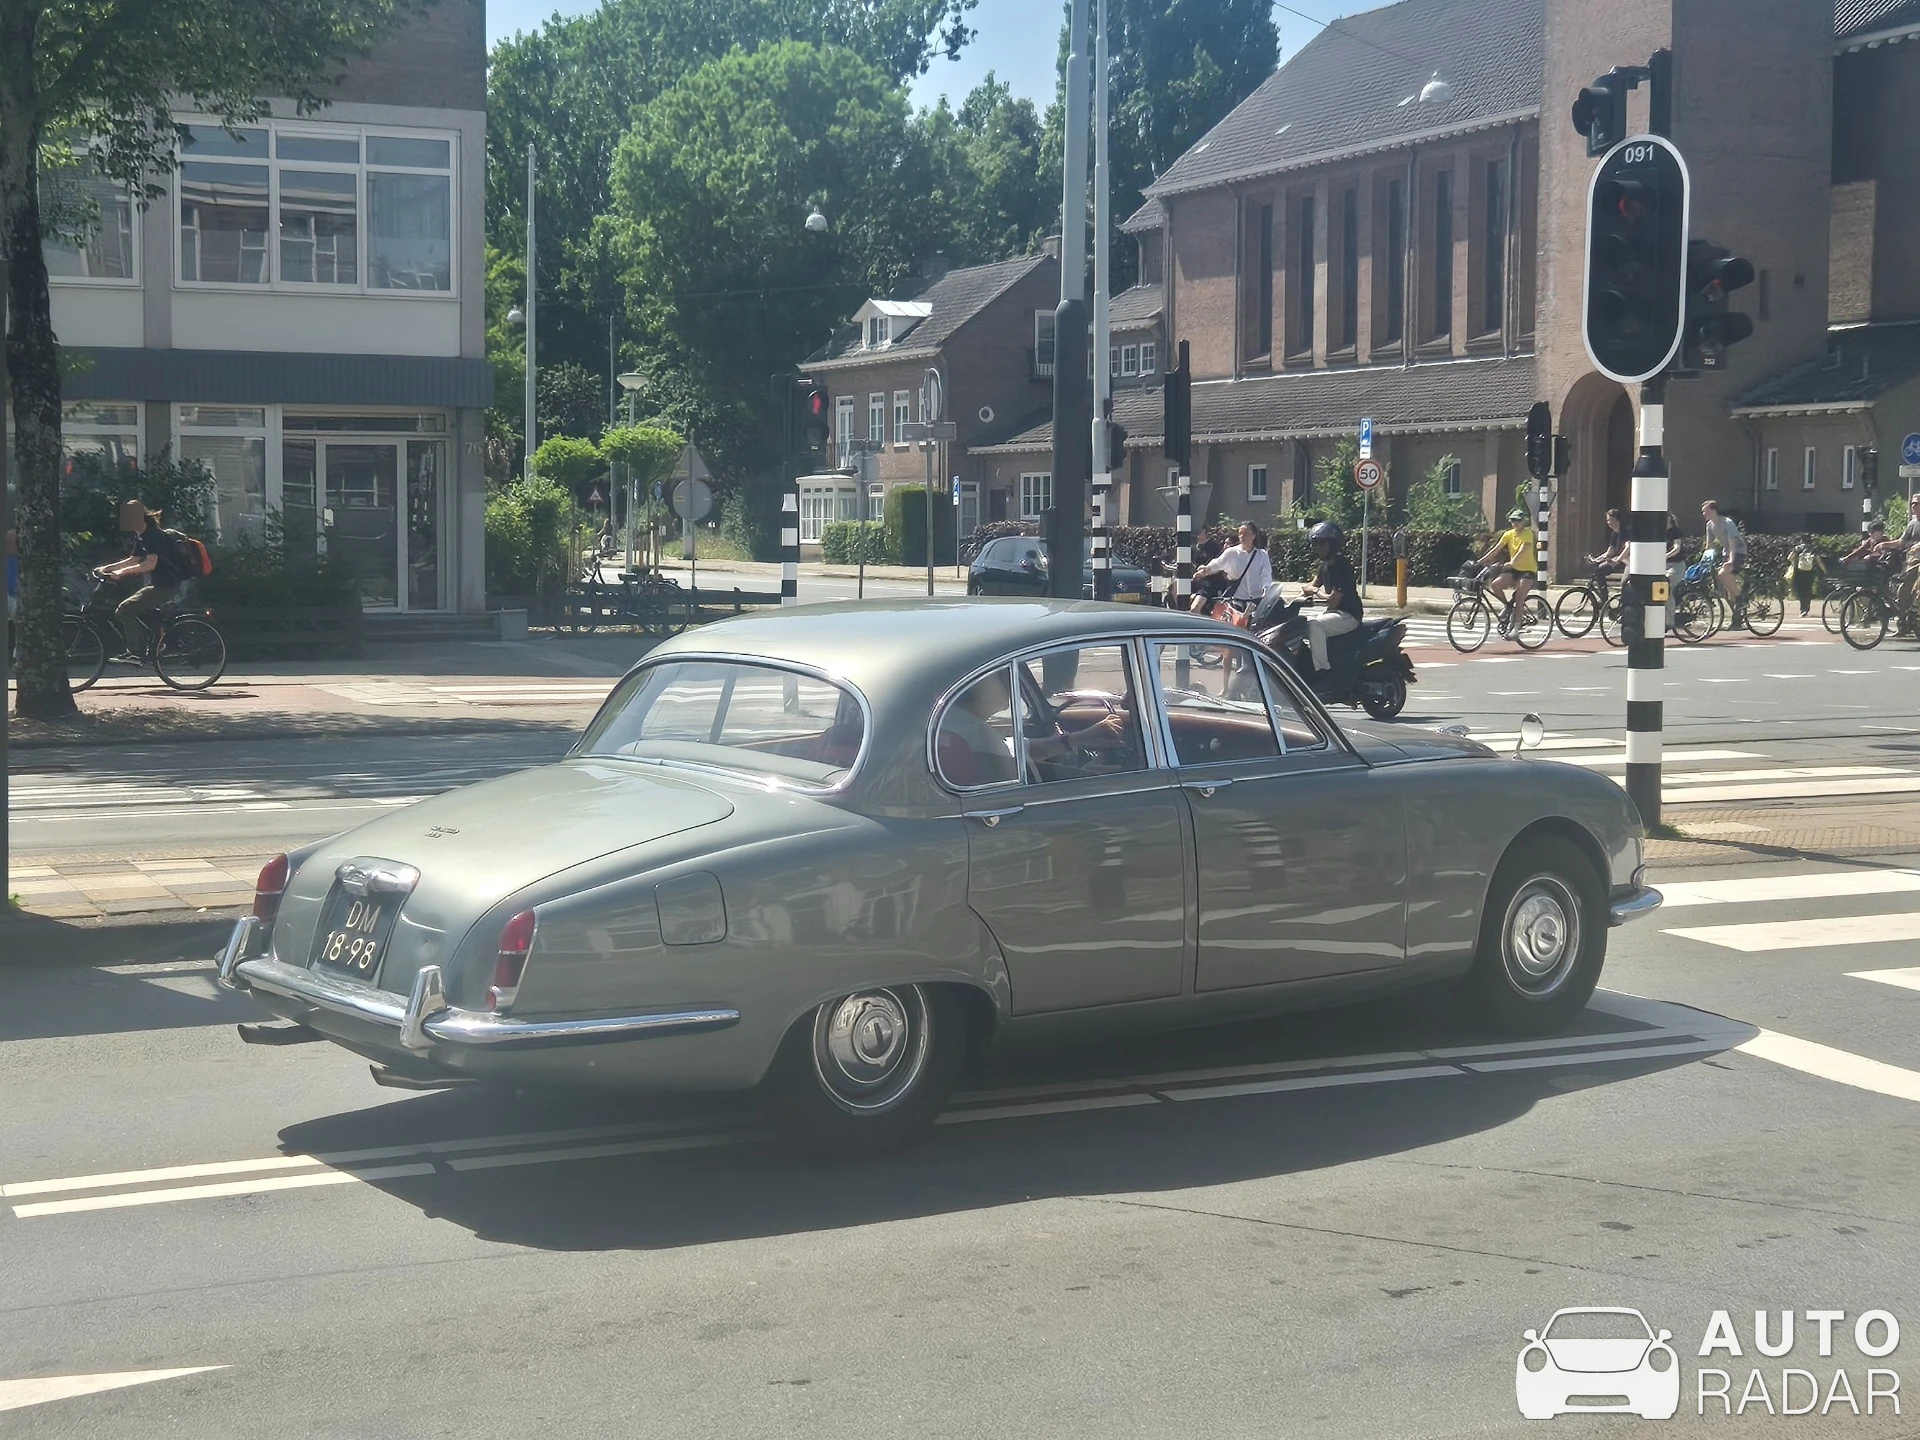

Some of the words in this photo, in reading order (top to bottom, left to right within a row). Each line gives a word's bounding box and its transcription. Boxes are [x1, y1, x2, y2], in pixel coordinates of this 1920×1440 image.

[1625, 144, 1654, 164] 091
[1363, 421, 1370, 437] P
[1360, 468, 1378, 480] 50
[346, 901, 381, 933] DM
[322, 930, 377, 969] 18-98
